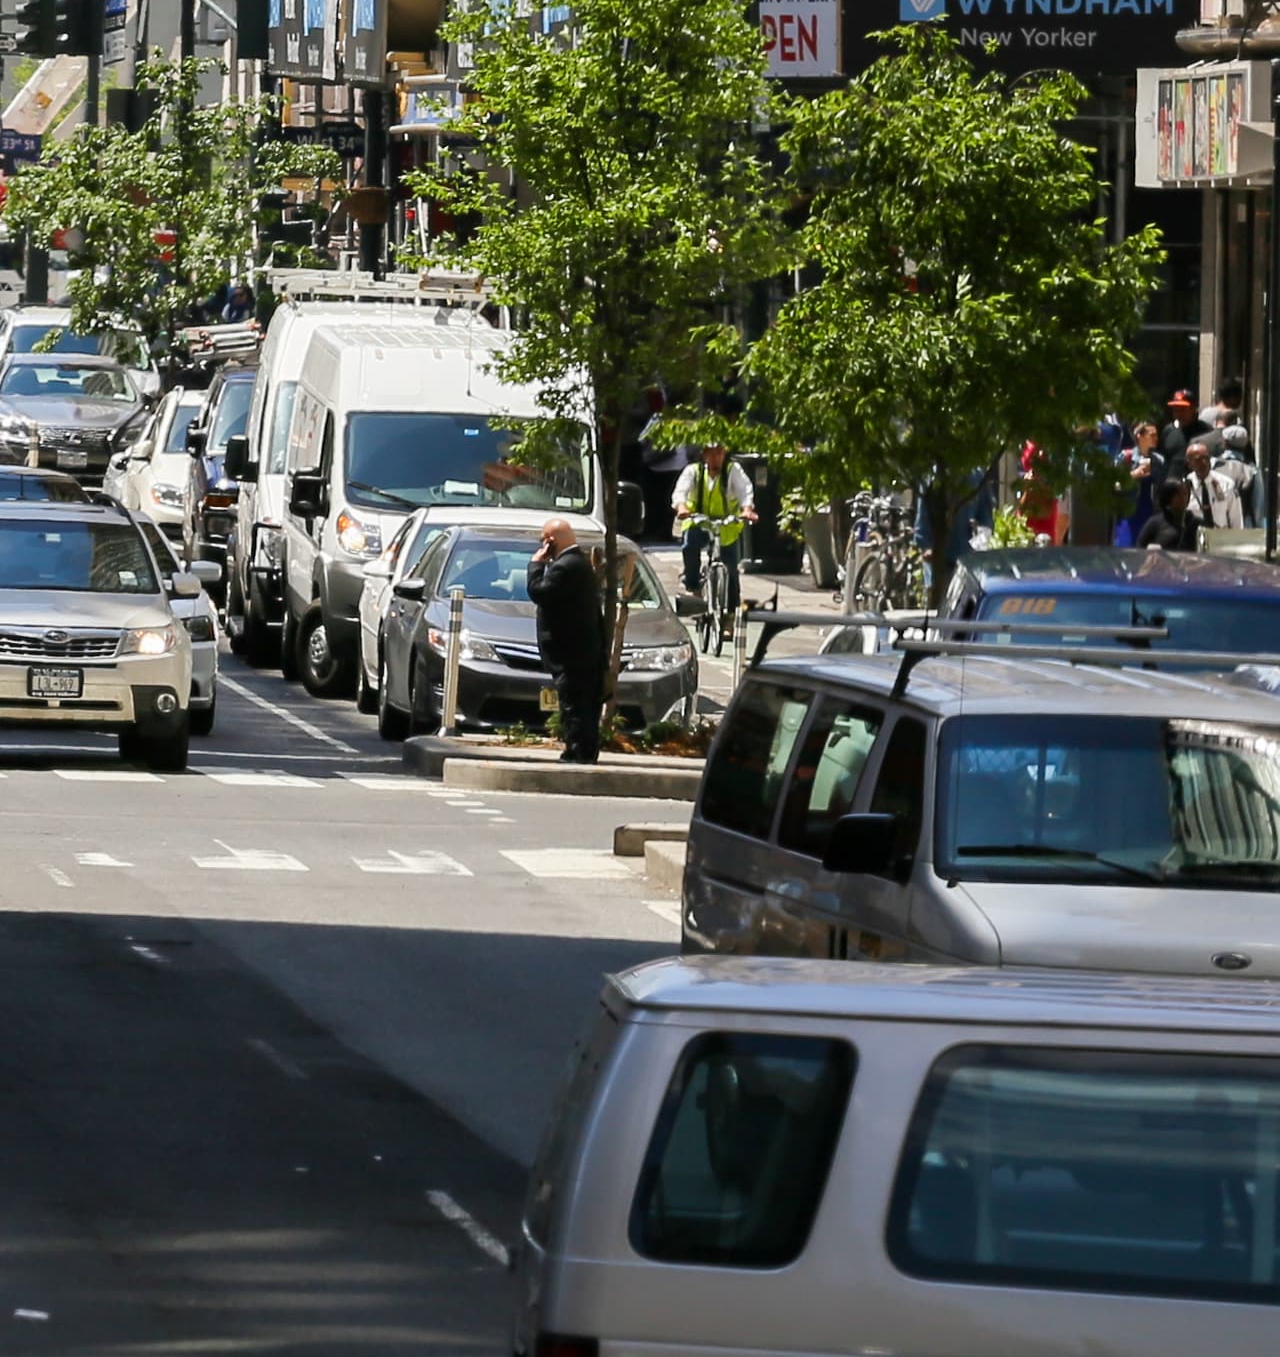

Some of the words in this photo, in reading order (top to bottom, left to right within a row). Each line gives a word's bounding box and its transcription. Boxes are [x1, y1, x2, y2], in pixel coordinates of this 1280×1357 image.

[760, 13, 818, 63] PEN
[960, 27, 1012, 47] New
[1019, 26, 1097, 48] Yorker
